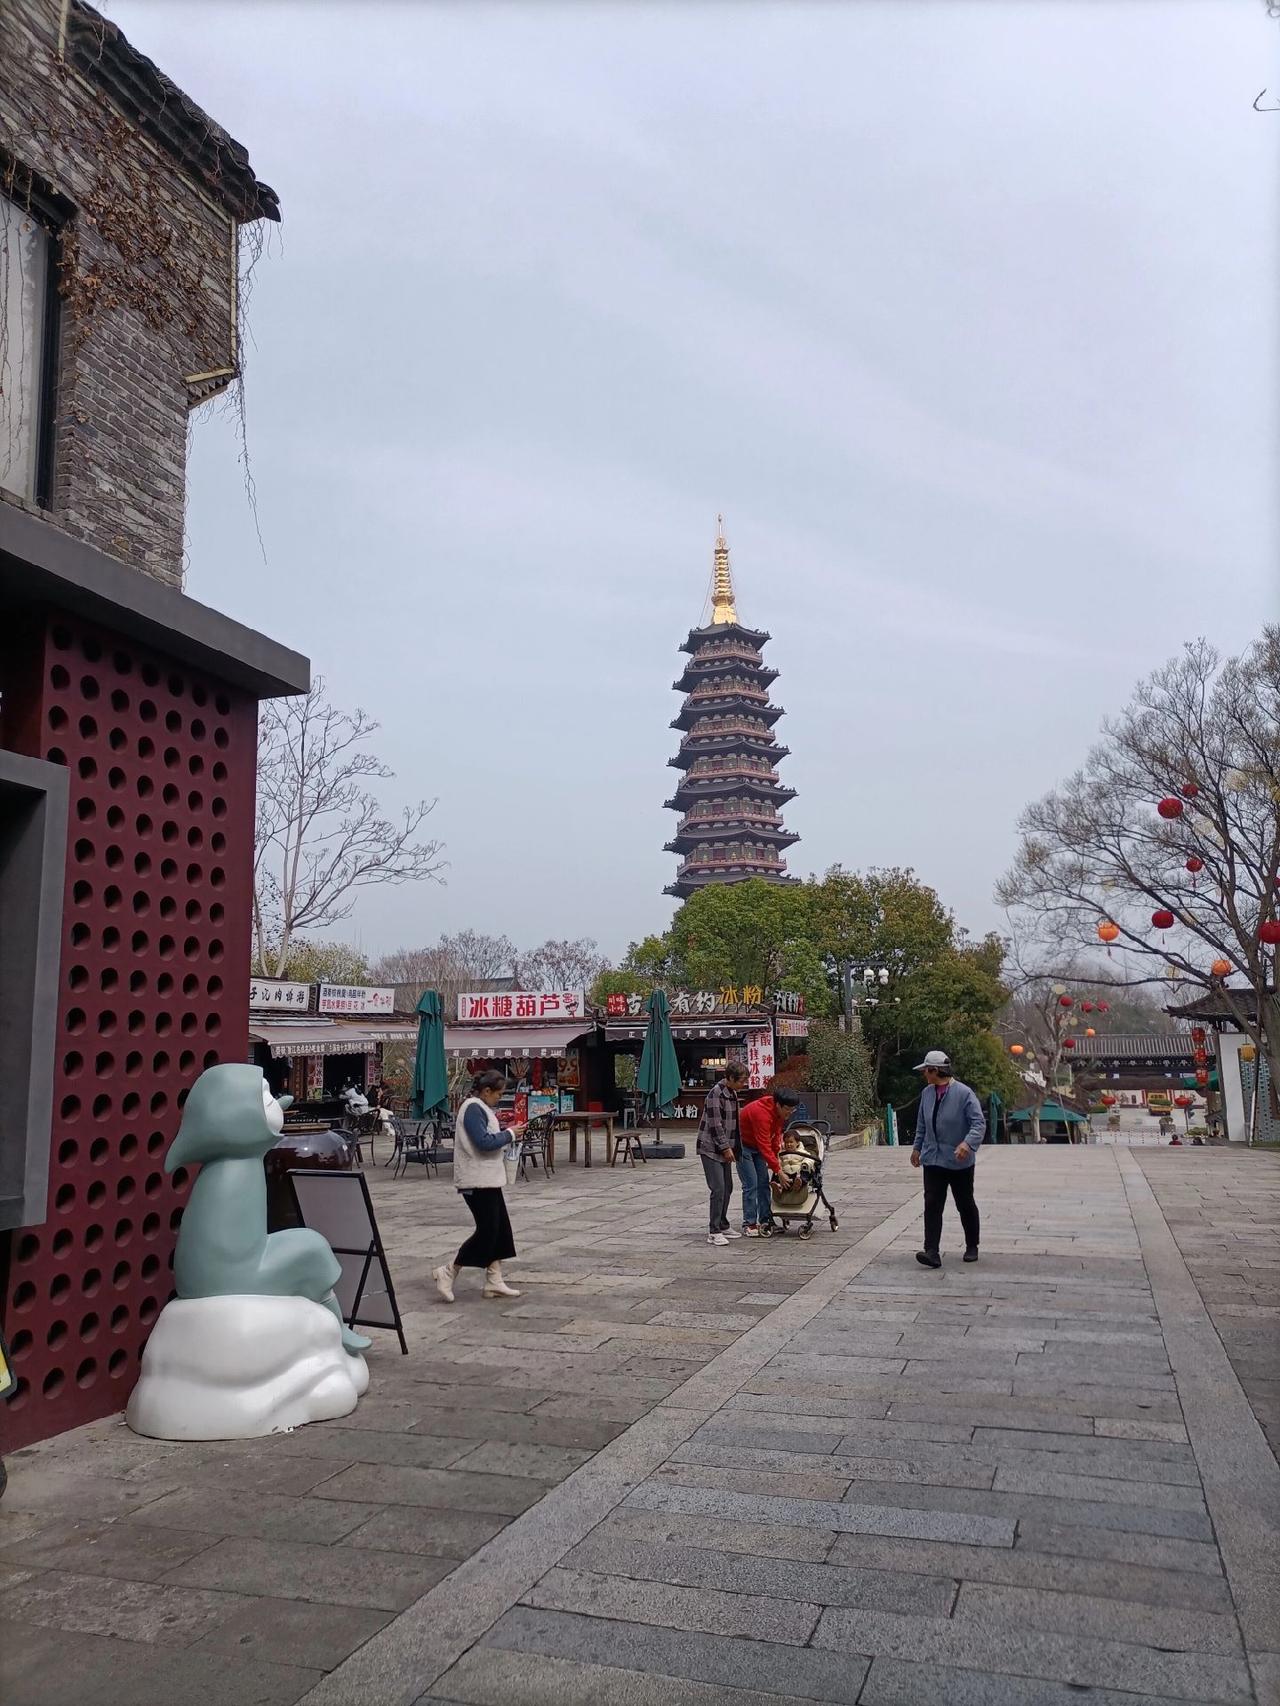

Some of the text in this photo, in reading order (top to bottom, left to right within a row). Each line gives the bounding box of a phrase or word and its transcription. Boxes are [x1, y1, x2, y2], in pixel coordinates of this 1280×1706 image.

[469, 994, 560, 1018] 冰糖葫芦
[760, 1033, 773, 1088] 酸辣粉
